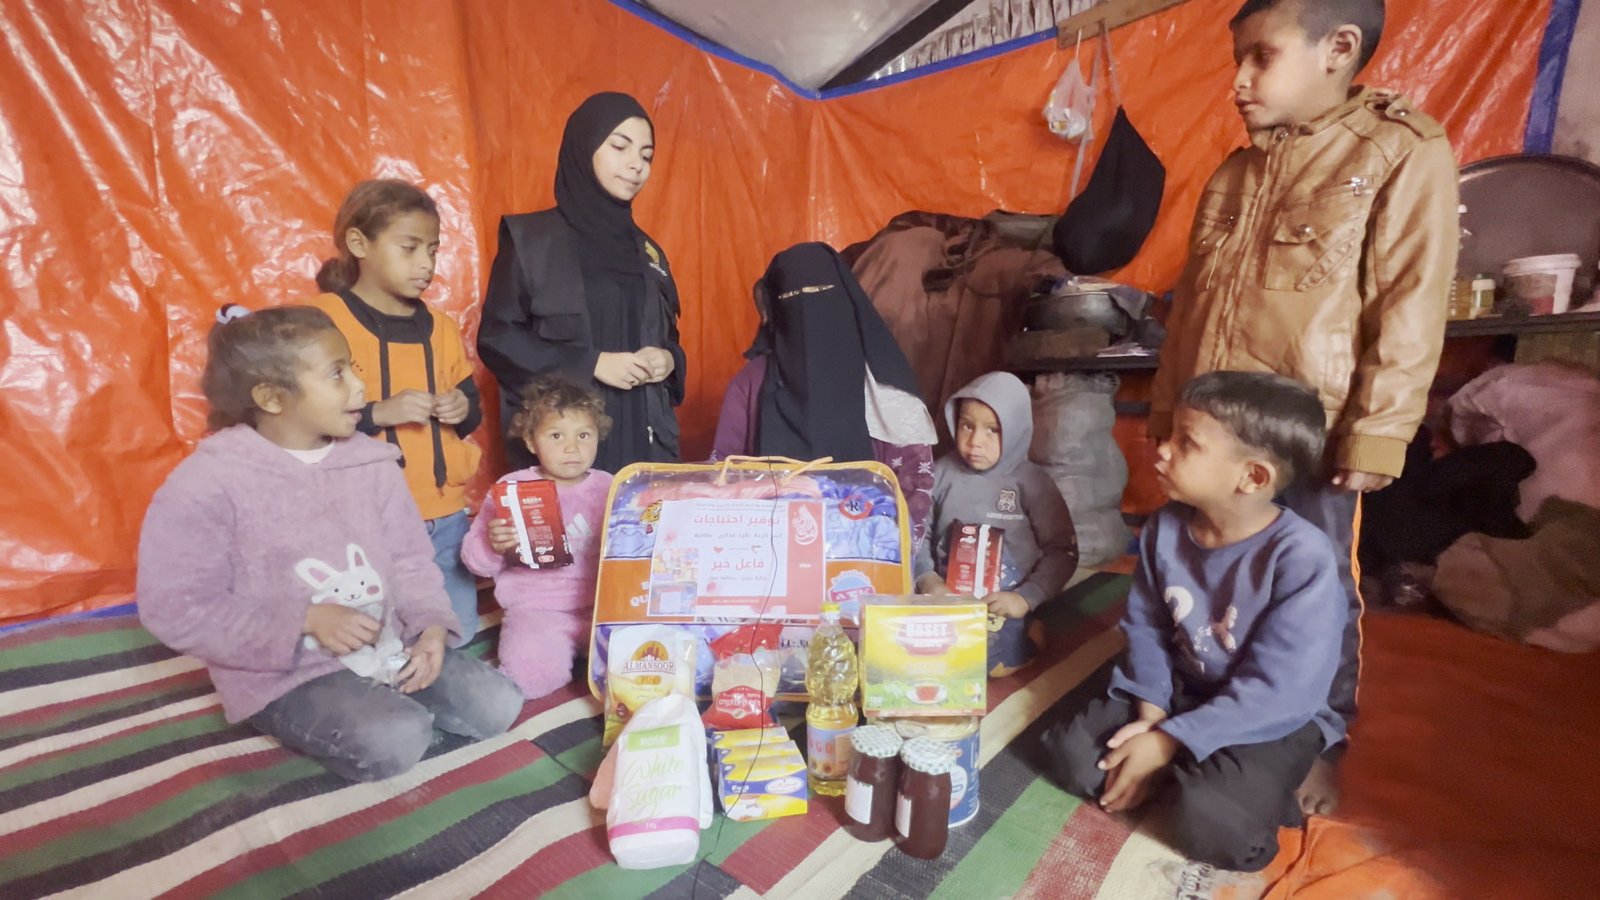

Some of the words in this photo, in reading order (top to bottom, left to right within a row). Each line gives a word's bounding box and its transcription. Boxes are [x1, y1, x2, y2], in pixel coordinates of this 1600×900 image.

[693, 514, 743, 526] احتياجات
[710, 558, 730, 571] خير
[735, 558, 765, 571] فاعل
[906, 622, 948, 638] BASET
[623, 660, 676, 673] ALMANSOOR
[622, 753, 686, 786] White
[625, 783, 689, 817] Sugar
